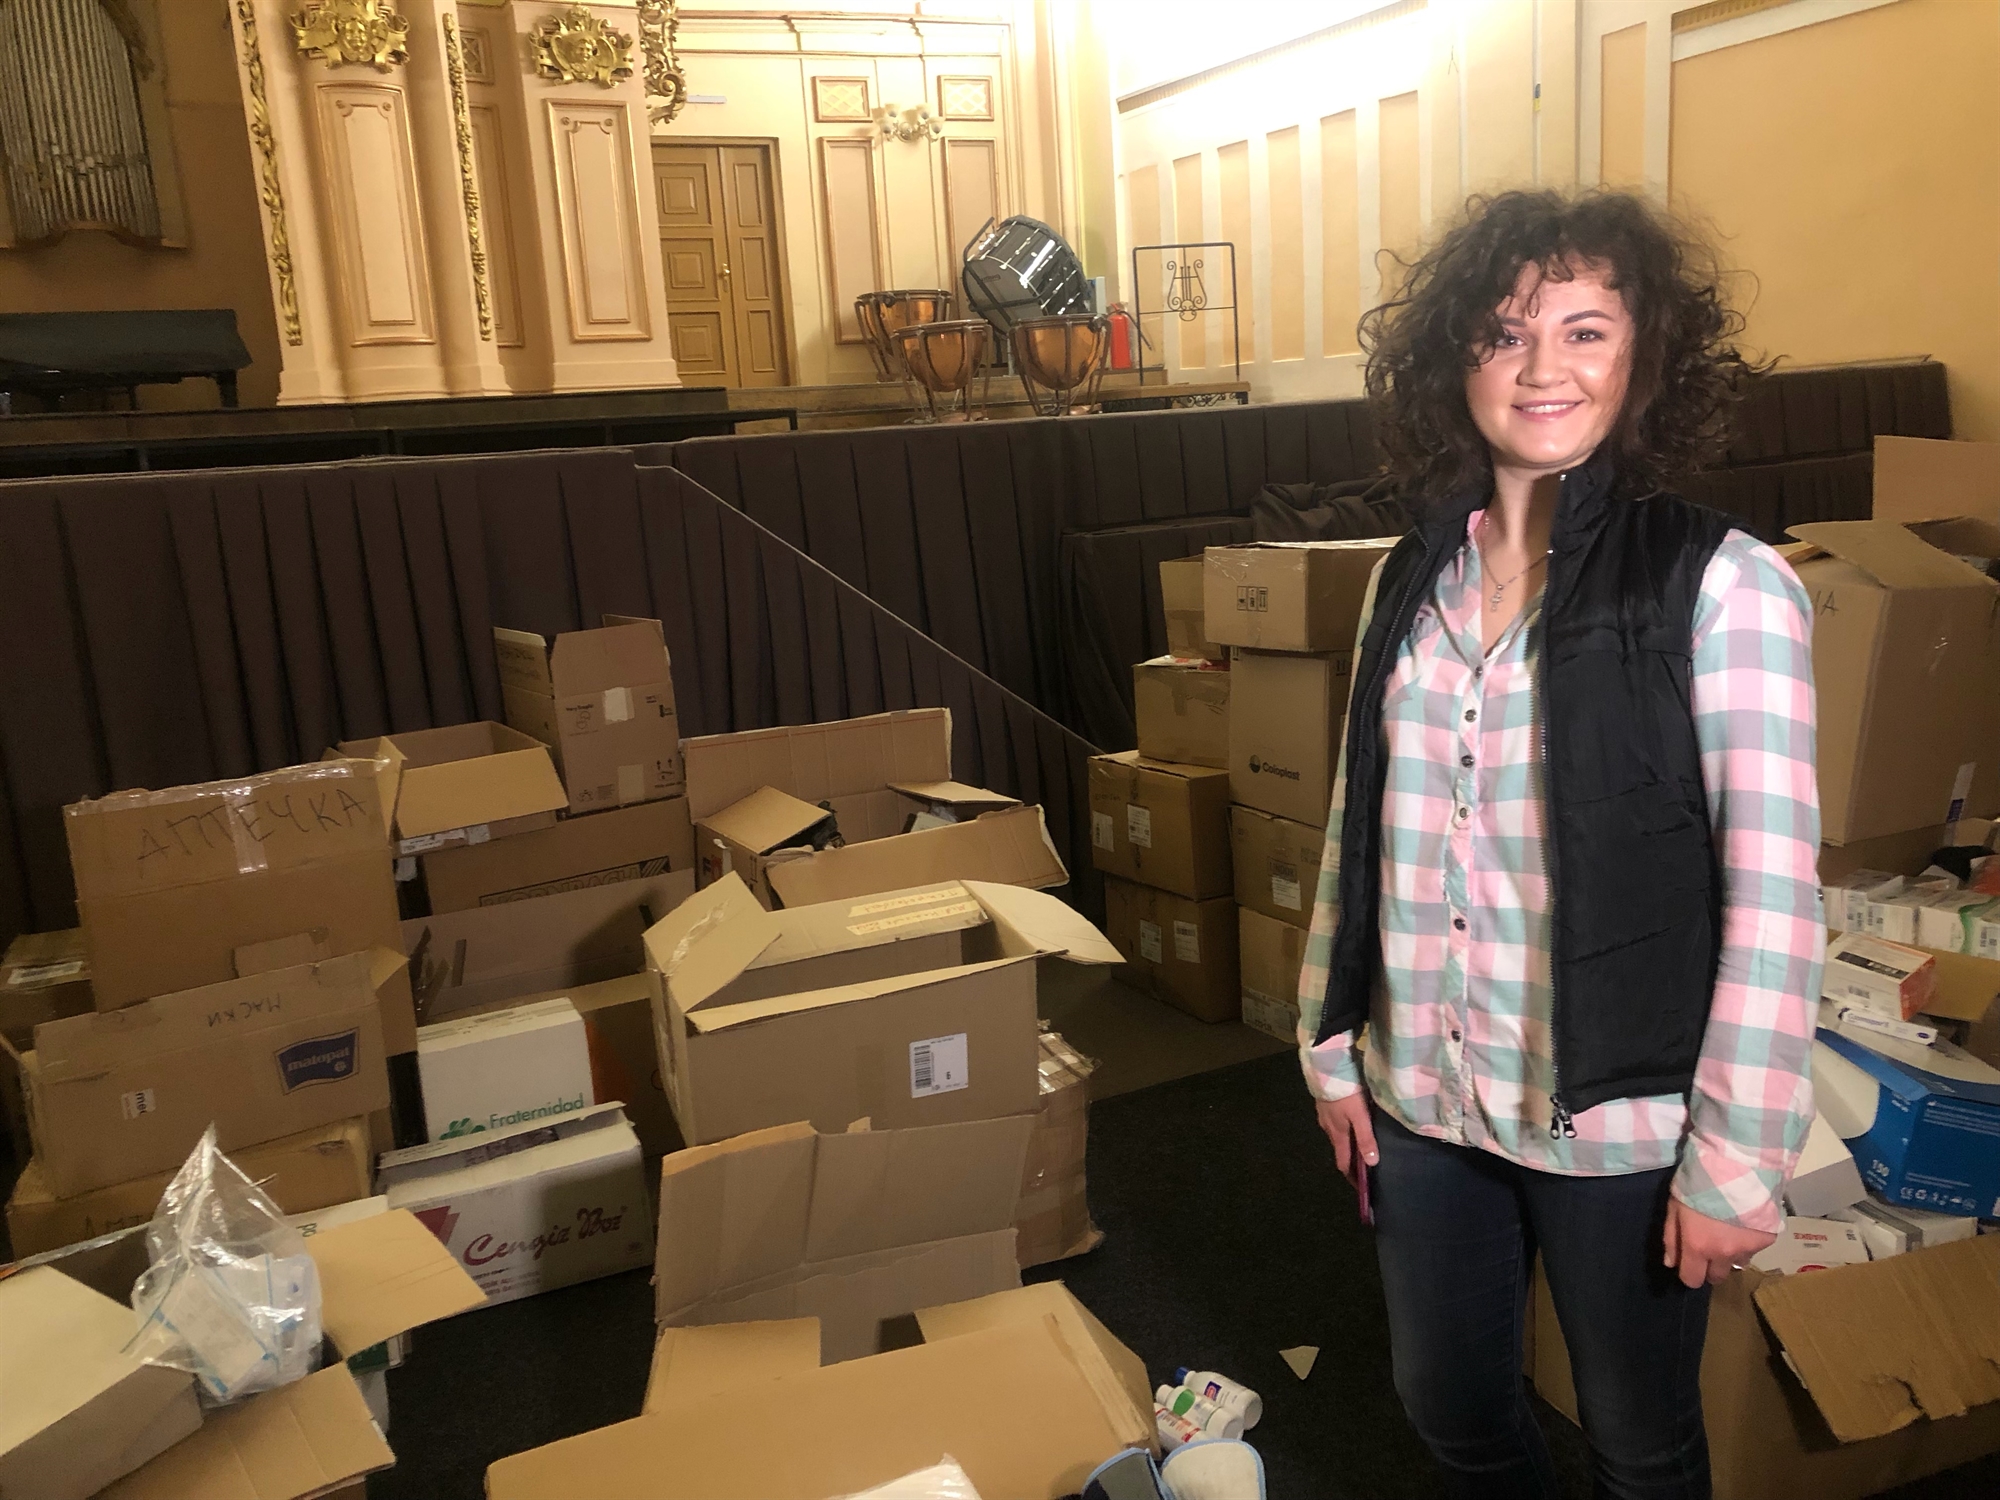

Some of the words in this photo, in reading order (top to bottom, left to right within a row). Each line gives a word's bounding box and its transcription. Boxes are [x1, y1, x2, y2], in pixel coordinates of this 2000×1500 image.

[1262, 761, 1301, 782] Coloplast
[137, 788, 367, 880] АПТЕЧКА
[287, 1046, 350, 1073] matopat
[489, 1092, 584, 1129] Fraternidad
[463, 1225, 572, 1266] Cengiz
[577, 1206, 623, 1240] Boz
